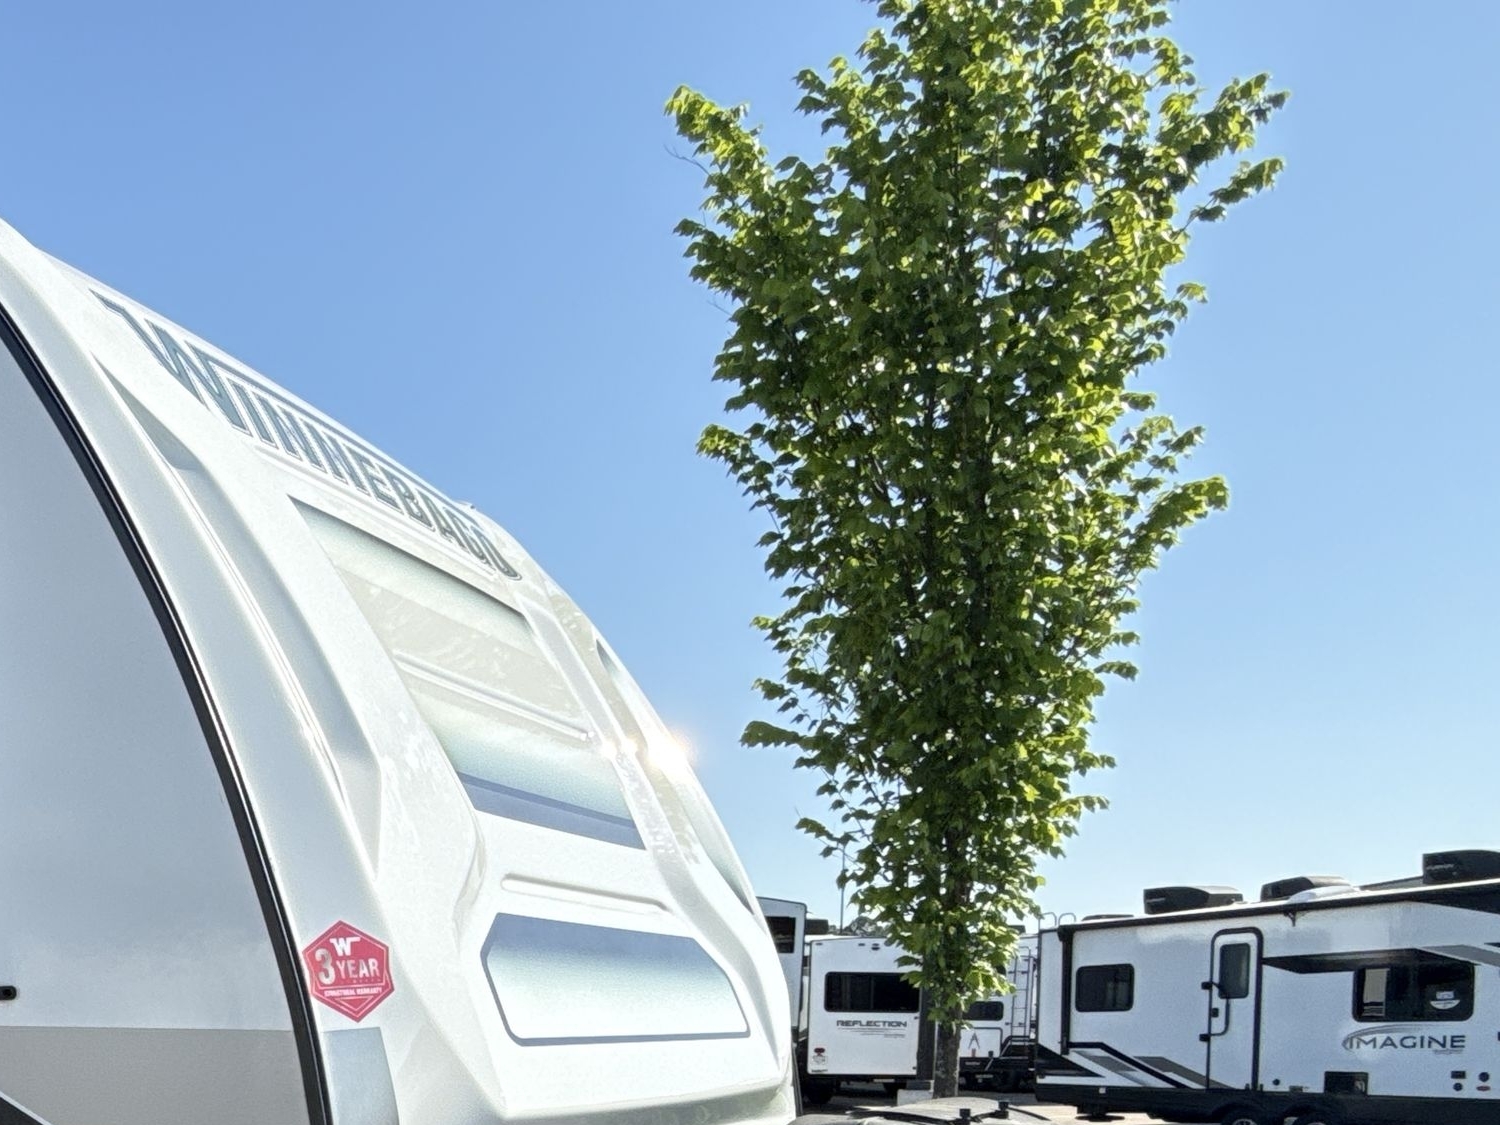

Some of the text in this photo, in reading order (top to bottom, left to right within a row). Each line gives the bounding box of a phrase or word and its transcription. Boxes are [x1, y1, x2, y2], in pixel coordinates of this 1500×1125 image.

[87, 287, 523, 581] WINNEBAGO
[314, 947, 380, 985] 3 YEAR
[836, 1019, 908, 1028] REFLECTION
[1349, 1034, 1467, 1050] IMAGINE
